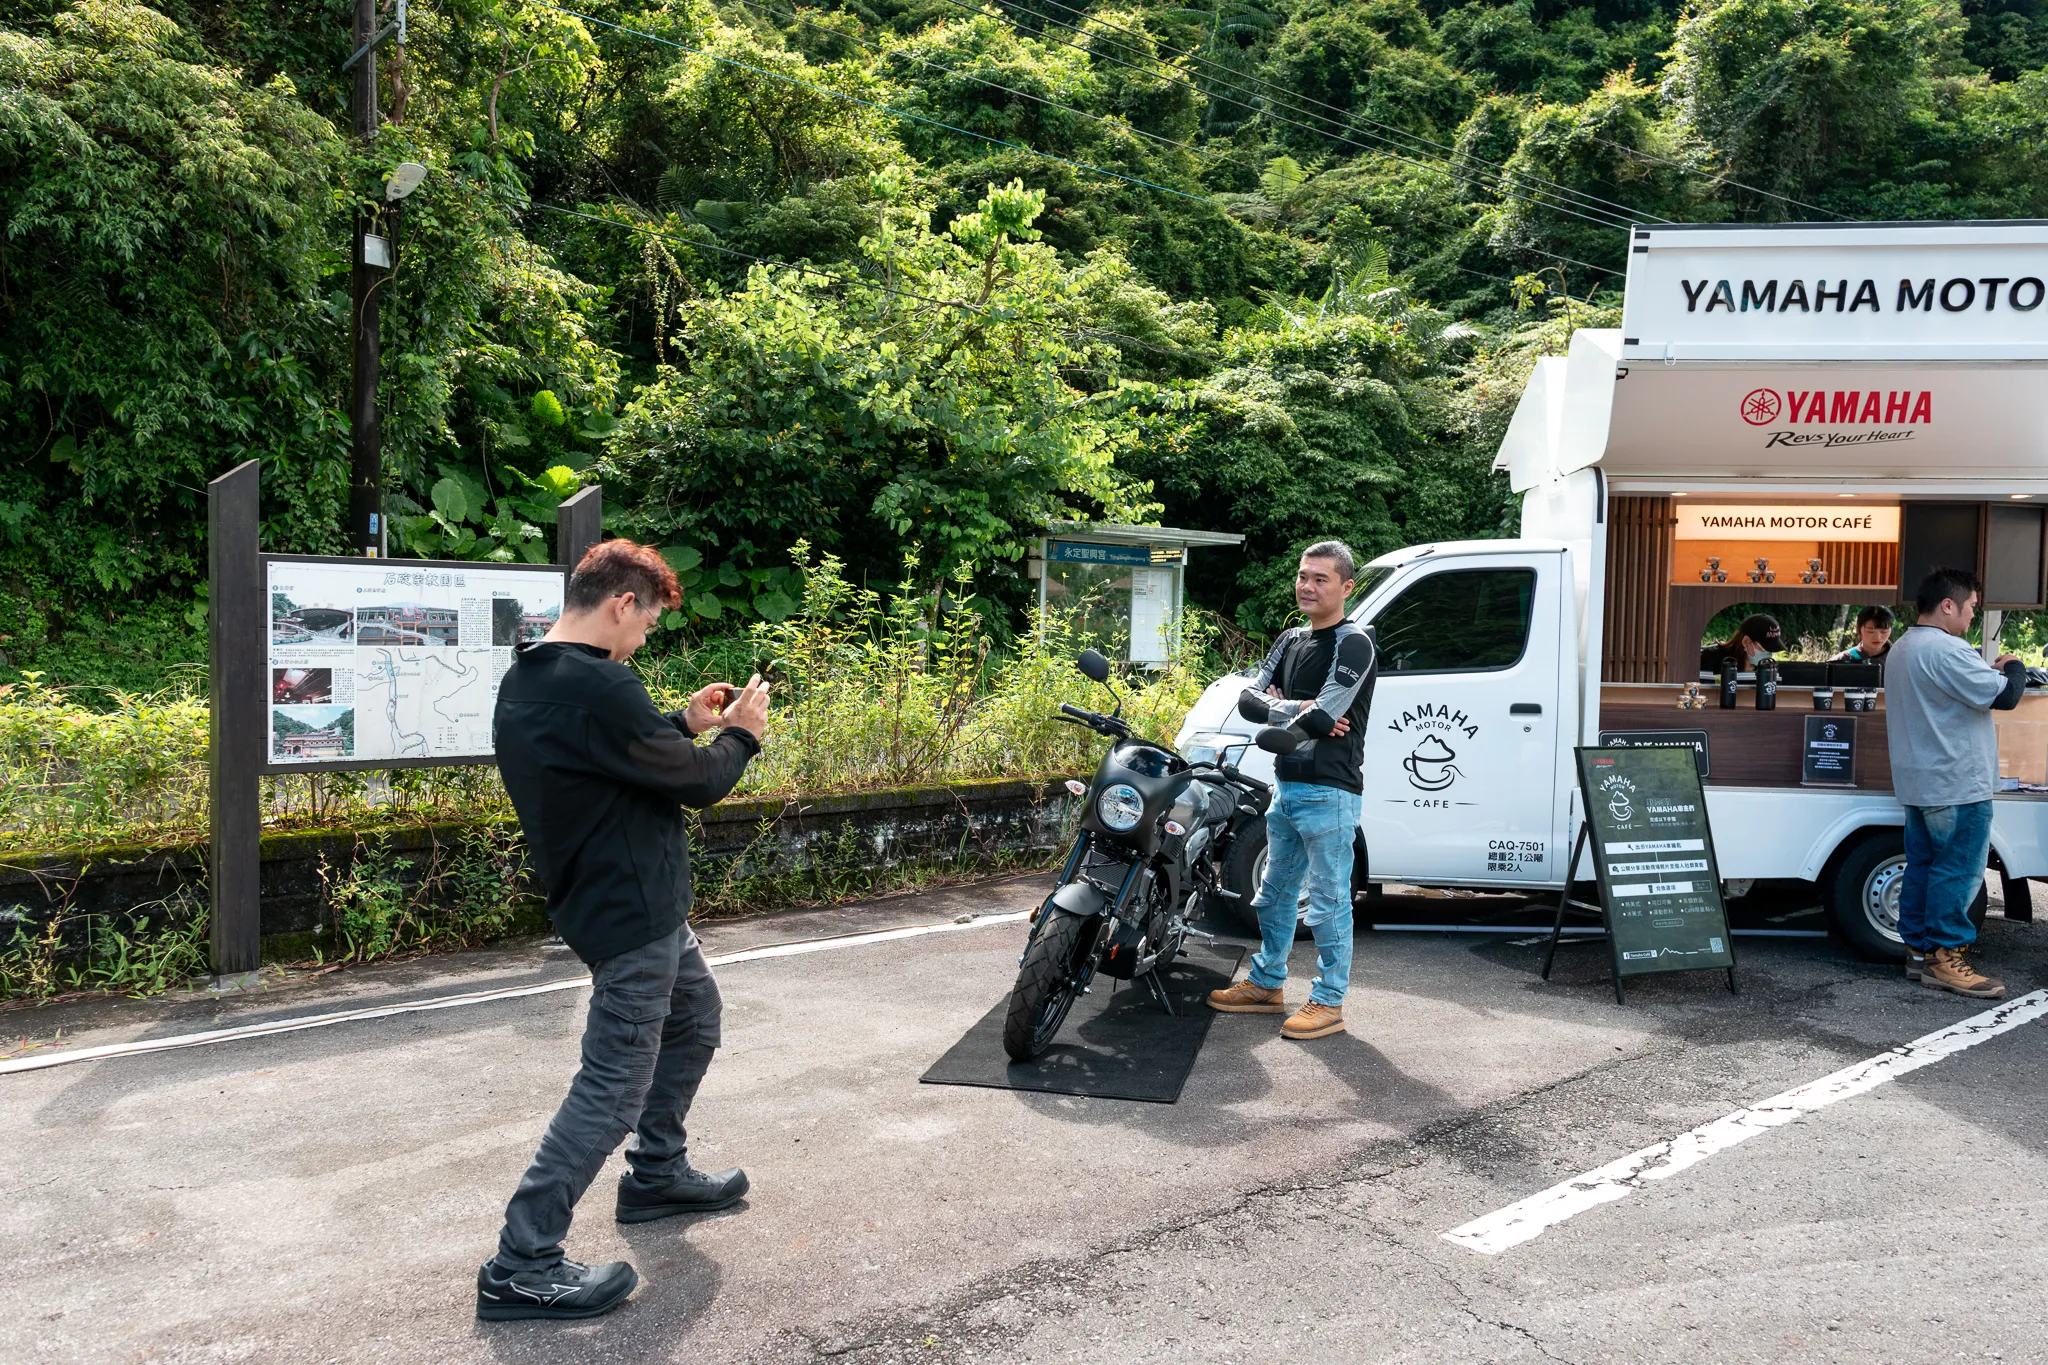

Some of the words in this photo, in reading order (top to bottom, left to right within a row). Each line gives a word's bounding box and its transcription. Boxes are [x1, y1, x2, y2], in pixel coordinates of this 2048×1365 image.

[1681, 279, 1881, 312] YAMAHA
[1896, 277, 2046, 312] MOTO
[1787, 391, 1931, 424] YAMAHA
[1765, 431, 1825, 448] Revs
[1824, 432, 1867, 447] Your
[1866, 430, 1914, 442] Heart
[1701, 516, 1766, 528] YAMAHA
[1770, 516, 1828, 528] MOTOR
[1832, 515, 1872, 529] CAFÉ
[1064, 547, 1106, 560] 永定聖興宮
[1388, 703, 1479, 740] YAMAHA
[1415, 720, 1452, 732] MOTOR
[1599, 774, 1636, 793] YAMAHA
[1413, 798, 1449, 809] CAFE
[1488, 840, 1544, 851] CAQ-7501
[1487, 862, 1523, 872] 限乘2人
